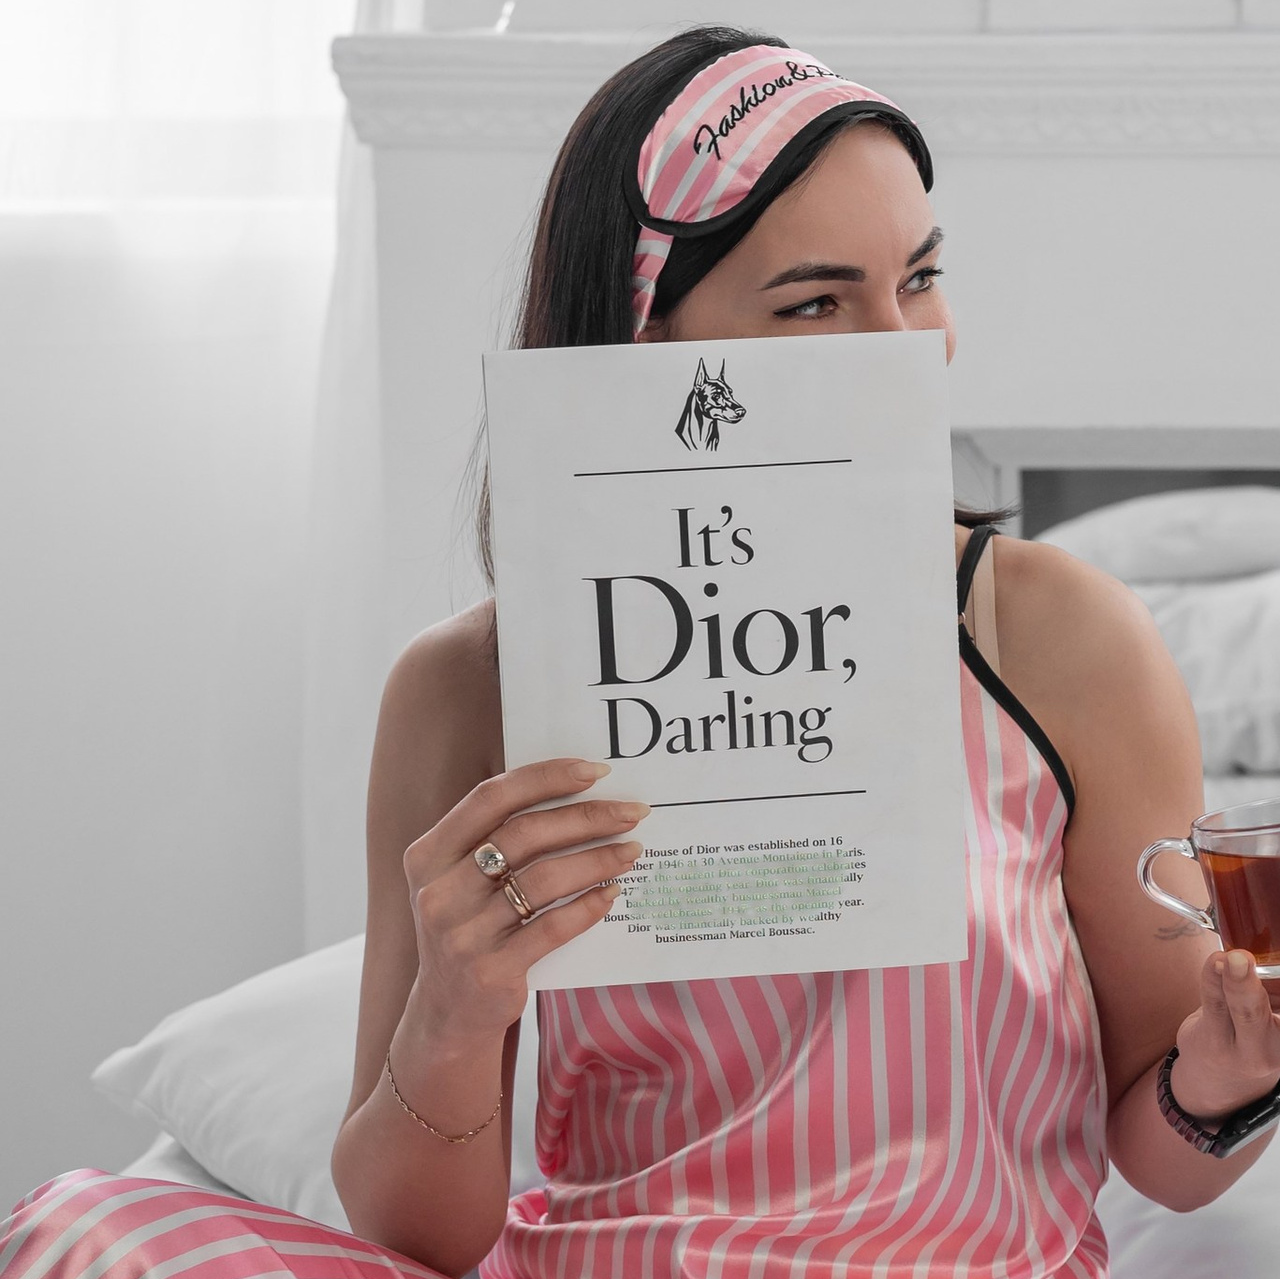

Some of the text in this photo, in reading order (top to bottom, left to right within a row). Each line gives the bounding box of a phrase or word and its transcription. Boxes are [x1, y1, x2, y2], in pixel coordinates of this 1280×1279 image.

[671, 504, 755, 569] It's
[582, 574, 858, 687] Dior,
[600, 689, 832, 763] Darling
[645, 836, 843, 858] House of Dior was established on 16
[659, 859, 684, 869] 1946
[687, 859, 697, 867] at
[701, 857, 715, 867] 30
[718, 855, 759, 865] Avenue
[763, 850, 819, 863] Montaigne
[822, 849, 833, 858] in
[836, 847, 866, 858] Paris.
[655, 872, 672, 882] the
[675, 870, 715, 881] current
[718, 869, 742, 878] Dior
[745, 864, 809, 877] corporation
[811, 861, 867, 872] celebrates
[658, 884, 675, 894] the
[678, 883, 722, 893] opening
[756, 879, 779, 889] Dior
[783, 877, 803, 886] was
[807, 872, 864, 884] financially
[626, 897, 665, 909] backed
[686, 894, 727, 905] wealthy
[732, 890, 802, 902] businessman
[806, 886, 842, 897] Marcel
[756, 904, 768, 913] as
[771, 902, 788, 912] the
[791, 900, 835, 911] opening
[838, 898, 865, 909] year.
[627, 911, 842, 933] Dior was financially backed by wealthy
[655, 925, 816, 944] businessman Marcel Boussac.
